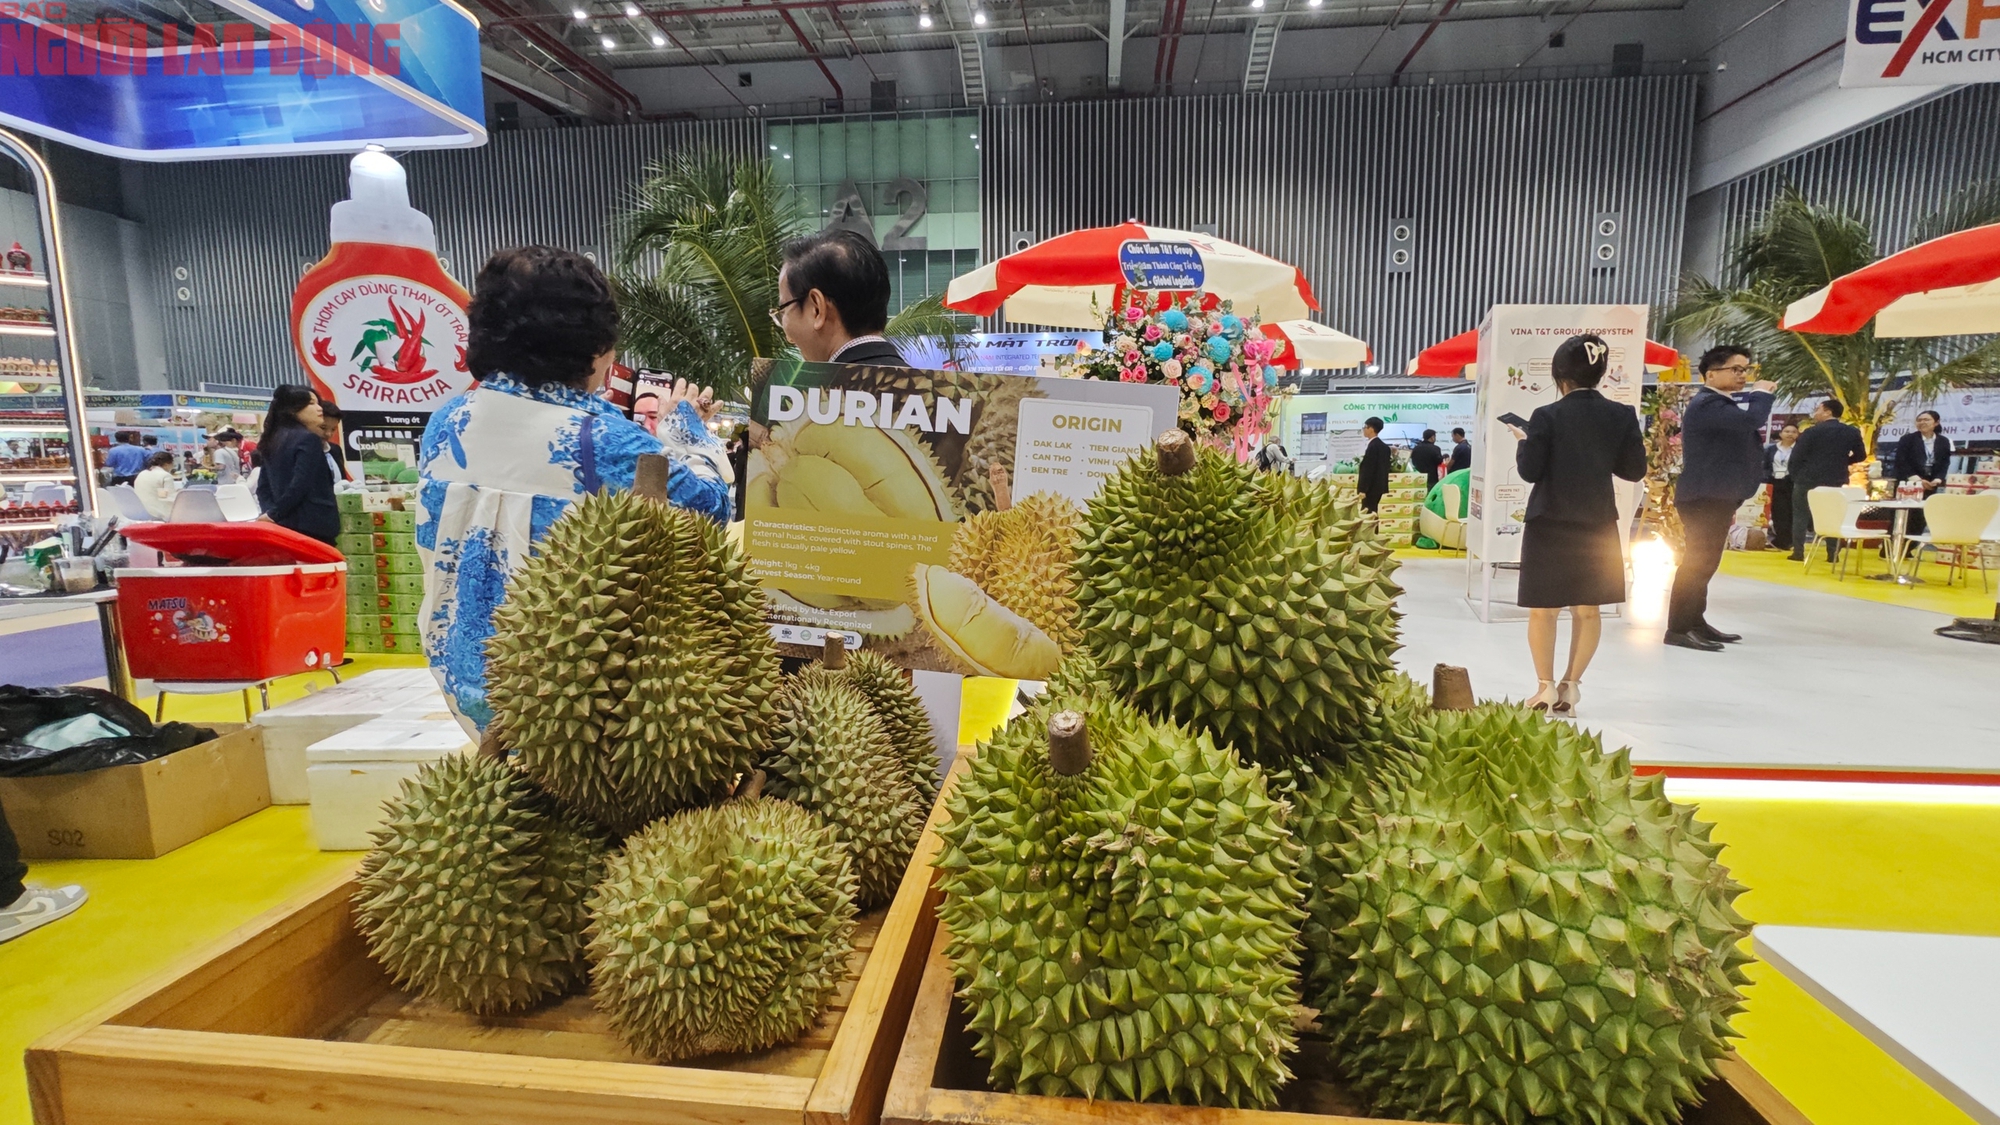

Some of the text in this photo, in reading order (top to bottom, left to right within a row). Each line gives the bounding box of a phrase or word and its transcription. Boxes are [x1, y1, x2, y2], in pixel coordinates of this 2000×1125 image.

[1922, 50, 1963, 64] HCM
[820, 177, 927, 251] A2
[1173, 244, 1193, 257] Group
[1152, 275, 1171, 287] Global
[1172, 274, 1195, 289] Logistics
[334, 287, 358, 306] CAY
[358, 281, 398, 296] DÙNG
[401, 285, 436, 306] THAY
[1510, 328, 1634, 336] VINA T&T GROUP ECOSYSTEM
[986, 338, 1028, 350] MẶT
[342, 373, 453, 404] SRIRACHA
[768, 384, 972, 435] DURIAN
[1344, 402, 1366, 410] CÔNG
[1052, 414, 1122, 433] ORIGIN
[1968, 425, 1984, 434] AN
[1033, 440, 1072, 450] DAK LAK
[1089, 444, 1140, 454] TIEN GIANG
[1032, 453, 1072, 462] CAN THO
[1088, 457, 1110, 466] VINH
[1031, 466, 1068, 476] BEN TRE
[753, 520, 816, 532] Characteristics:
[818, 525, 861, 536] Distinctive
[862, 530, 889, 539] aroma
[891, 532, 910, 541] with
[918, 534, 938, 543] hard
[752, 530, 932, 552] external husk, covered with stout spines. The
[752, 539, 857, 556] flesh is usually pale yellow.
[752, 558, 783, 569] Weight:
[784, 561, 798, 570] 1kg
[804, 563, 820, 572] 4kg
[784, 570, 815, 580] Season:
[816, 574, 862, 584] Year-round
[148, 598, 187, 610] MATSU
[800, 606, 810, 615] by
[812, 608, 827, 616] U.S.
[829, 609, 856, 618] Export
[823, 618, 872, 630] Recognized
[48, 829, 86, 847] S02
